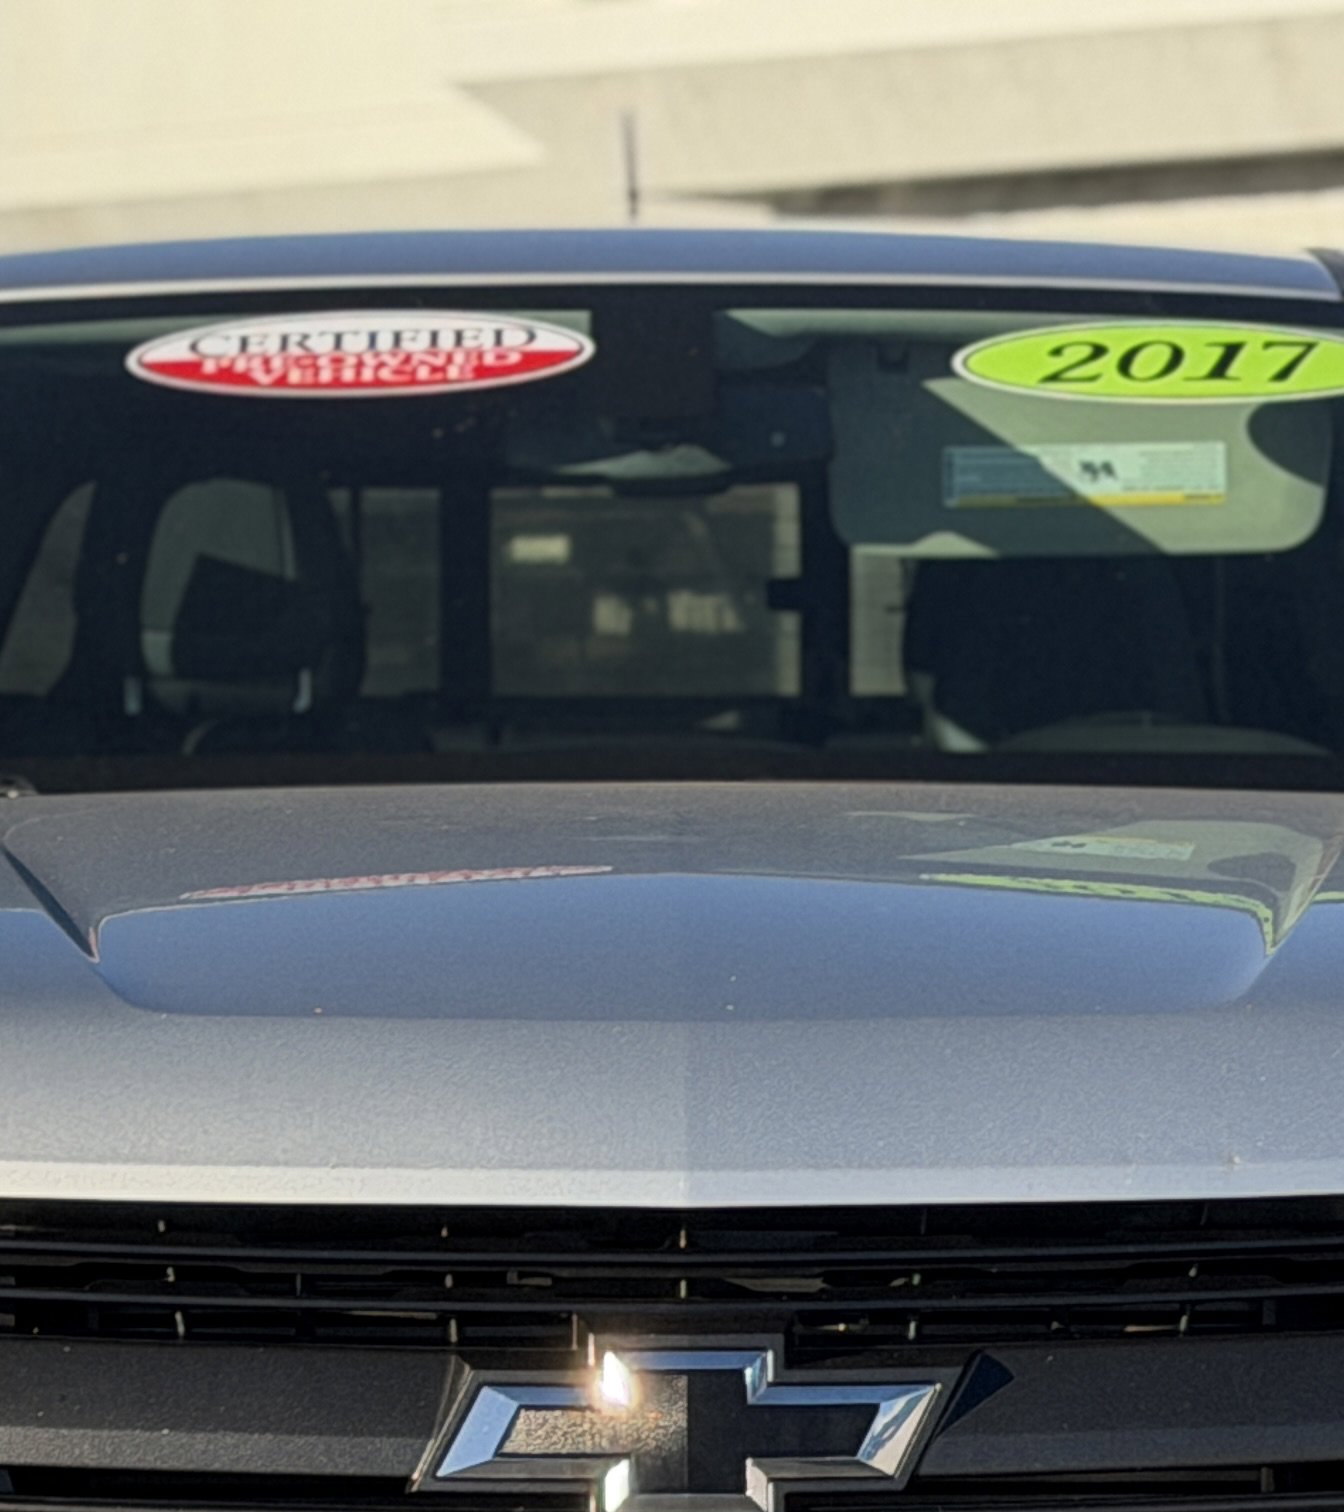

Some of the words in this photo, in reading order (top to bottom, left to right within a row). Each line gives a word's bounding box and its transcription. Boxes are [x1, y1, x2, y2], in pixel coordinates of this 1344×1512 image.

[188, 327, 538, 357] CERTIFIED
[248, 364, 476, 386] VEHICLE
[1035, 340, 1320, 385] 2017
